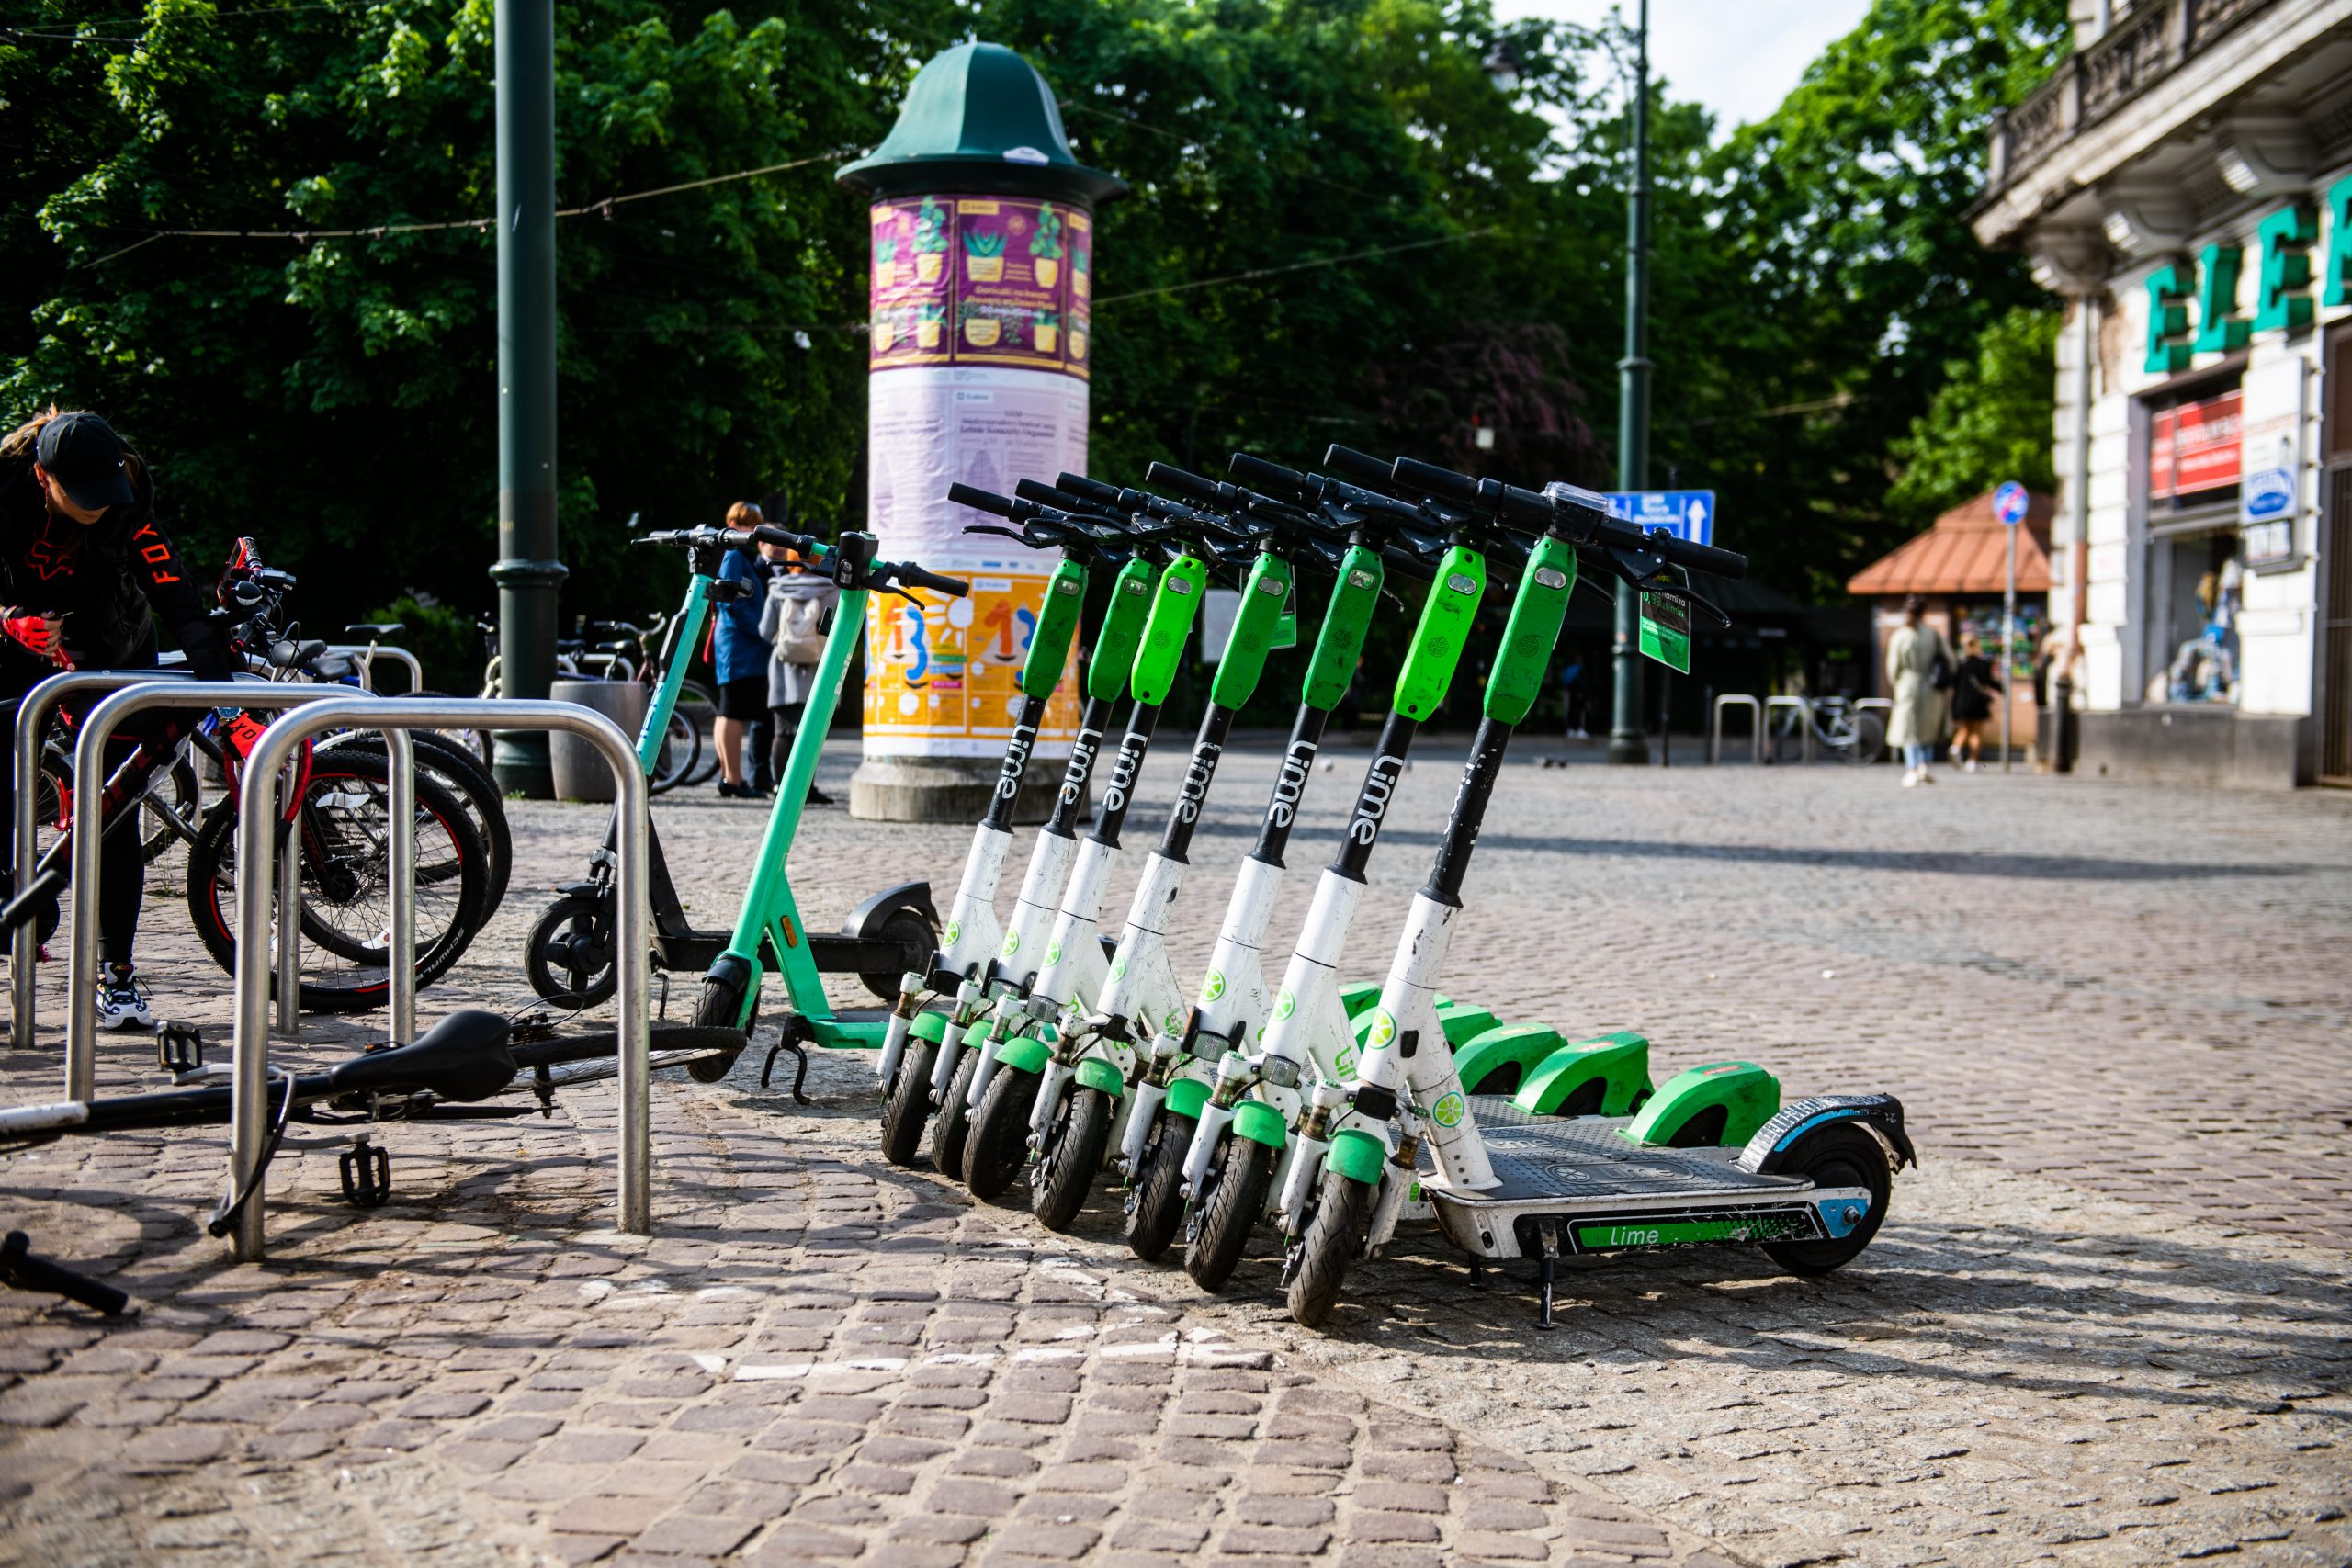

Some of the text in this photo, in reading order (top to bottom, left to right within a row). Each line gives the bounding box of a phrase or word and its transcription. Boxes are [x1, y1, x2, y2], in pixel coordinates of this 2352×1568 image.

[132, 523, 181, 584] FOX
[995, 724, 1037, 800] Lime
[1058, 728, 1103, 806] Lime
[1102, 731, 1149, 812] Lime
[1174, 740, 1223, 825] Lime
[1268, 739, 1318, 829] Lime
[1351, 755, 1405, 846] Lime
[1484, 1139, 1554, 1150] Lime
[1598, 1166, 1676, 1179] Lime
[1610, 1226, 1659, 1246] Lime
